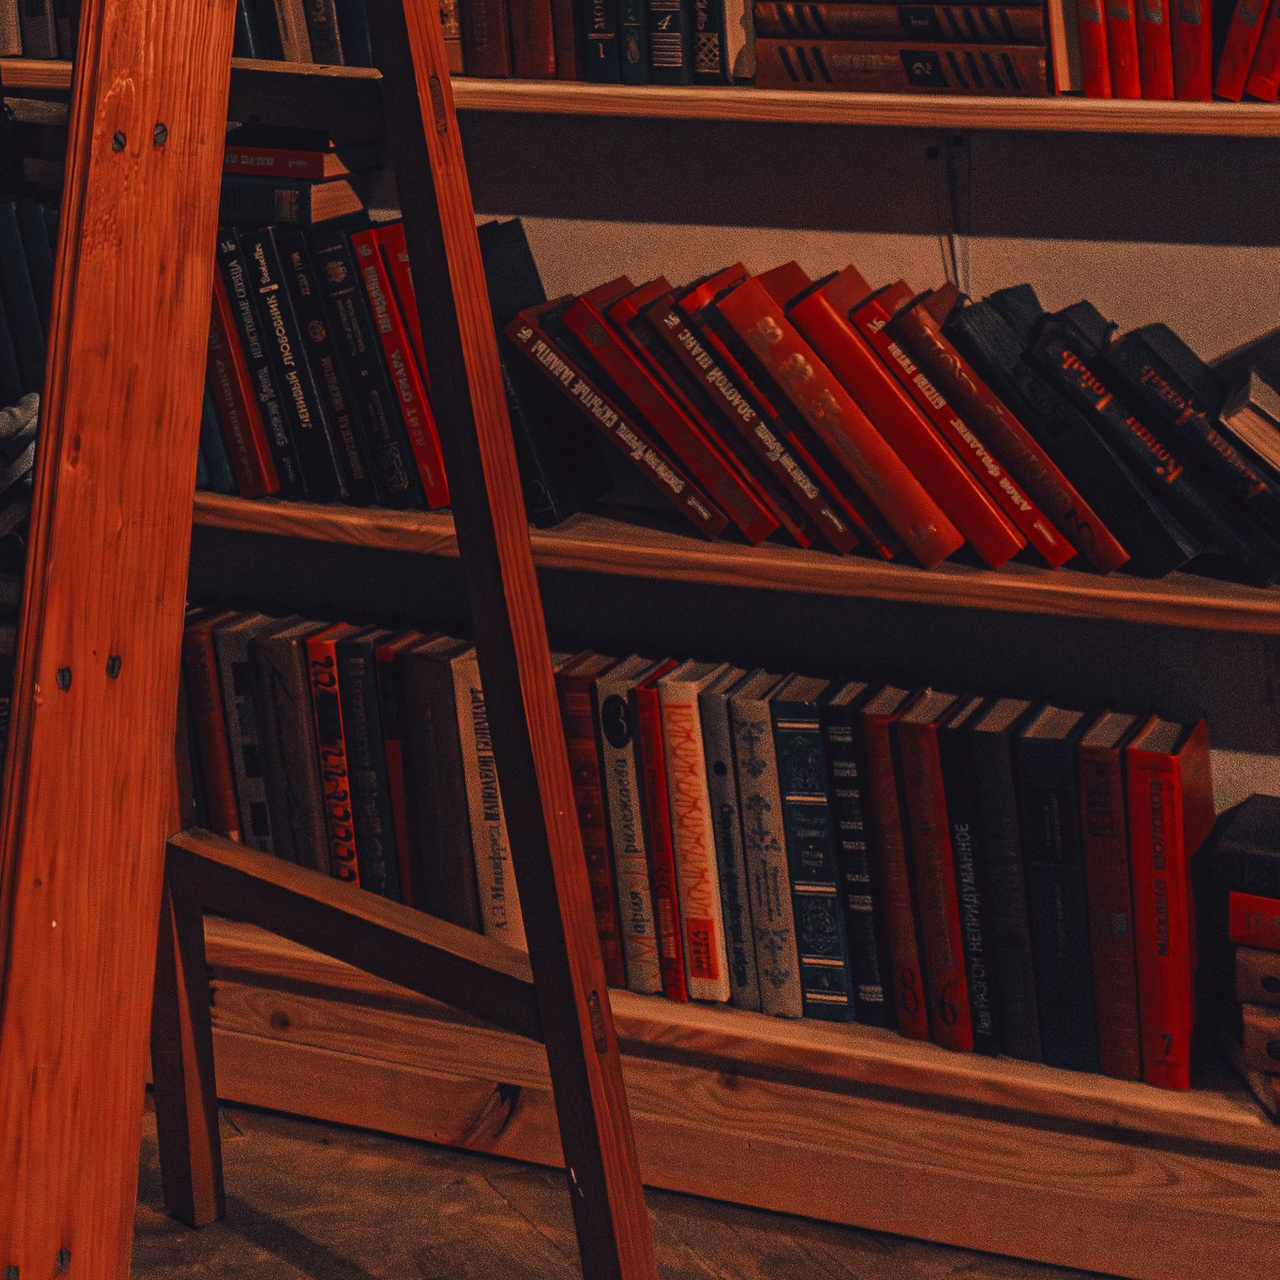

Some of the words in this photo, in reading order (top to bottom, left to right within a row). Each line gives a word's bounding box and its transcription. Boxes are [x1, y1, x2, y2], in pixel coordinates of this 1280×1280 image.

[238, 298, 262, 358] НЕИСТОВЫЕ
[264, 293, 295, 367] ЛЮБОВНИК
[676, 327, 714, 370] ШАНС
[529, 338, 576, 384] ТАЛАНТЫ
[285, 369, 312, 429] ЛЕНИВЫЙ
[569, 378, 619, 427] СКРЫТЫЕ
[704, 365, 756, 422] ЗОЛОТОЙ
[477, 753, 498, 821] НАПОЛЕОН
[954, 821, 983, 953] НЕПРИДУМАННОЕ
